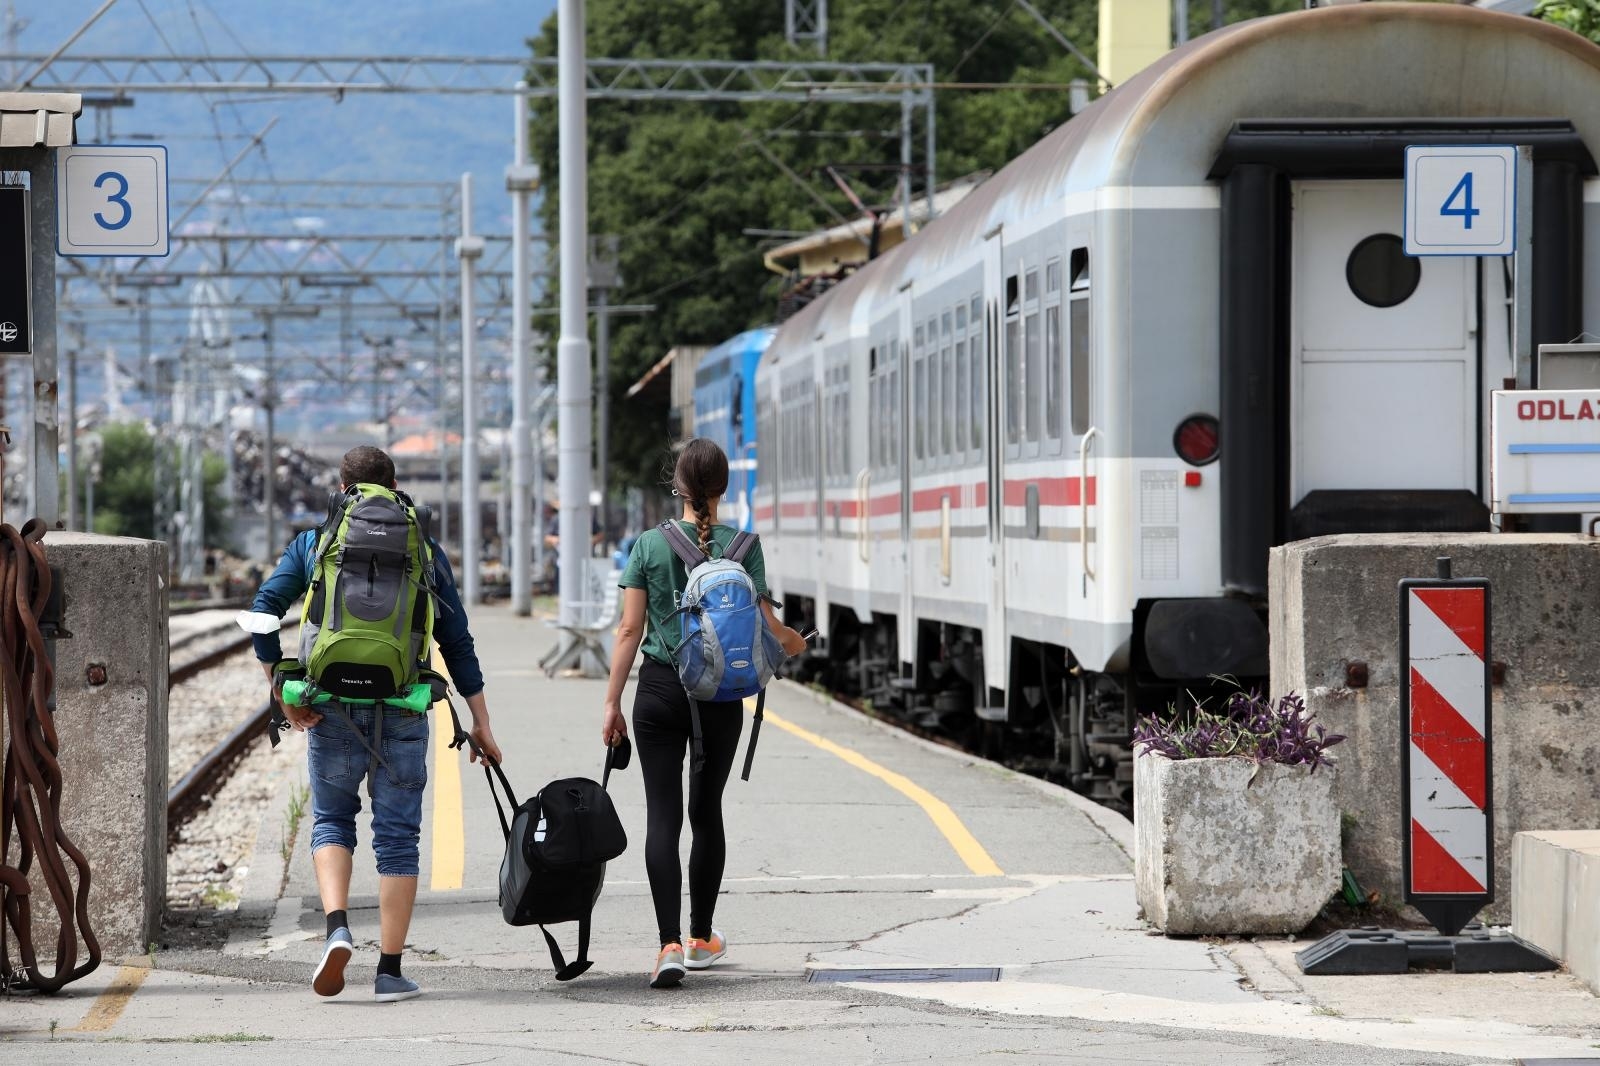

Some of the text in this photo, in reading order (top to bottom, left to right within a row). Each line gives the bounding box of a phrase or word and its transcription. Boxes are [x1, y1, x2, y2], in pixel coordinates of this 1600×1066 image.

[93, 171, 132, 231] 3
[1439, 171, 1480, 230] 4
[1517, 398, 1600, 420] ODLA
